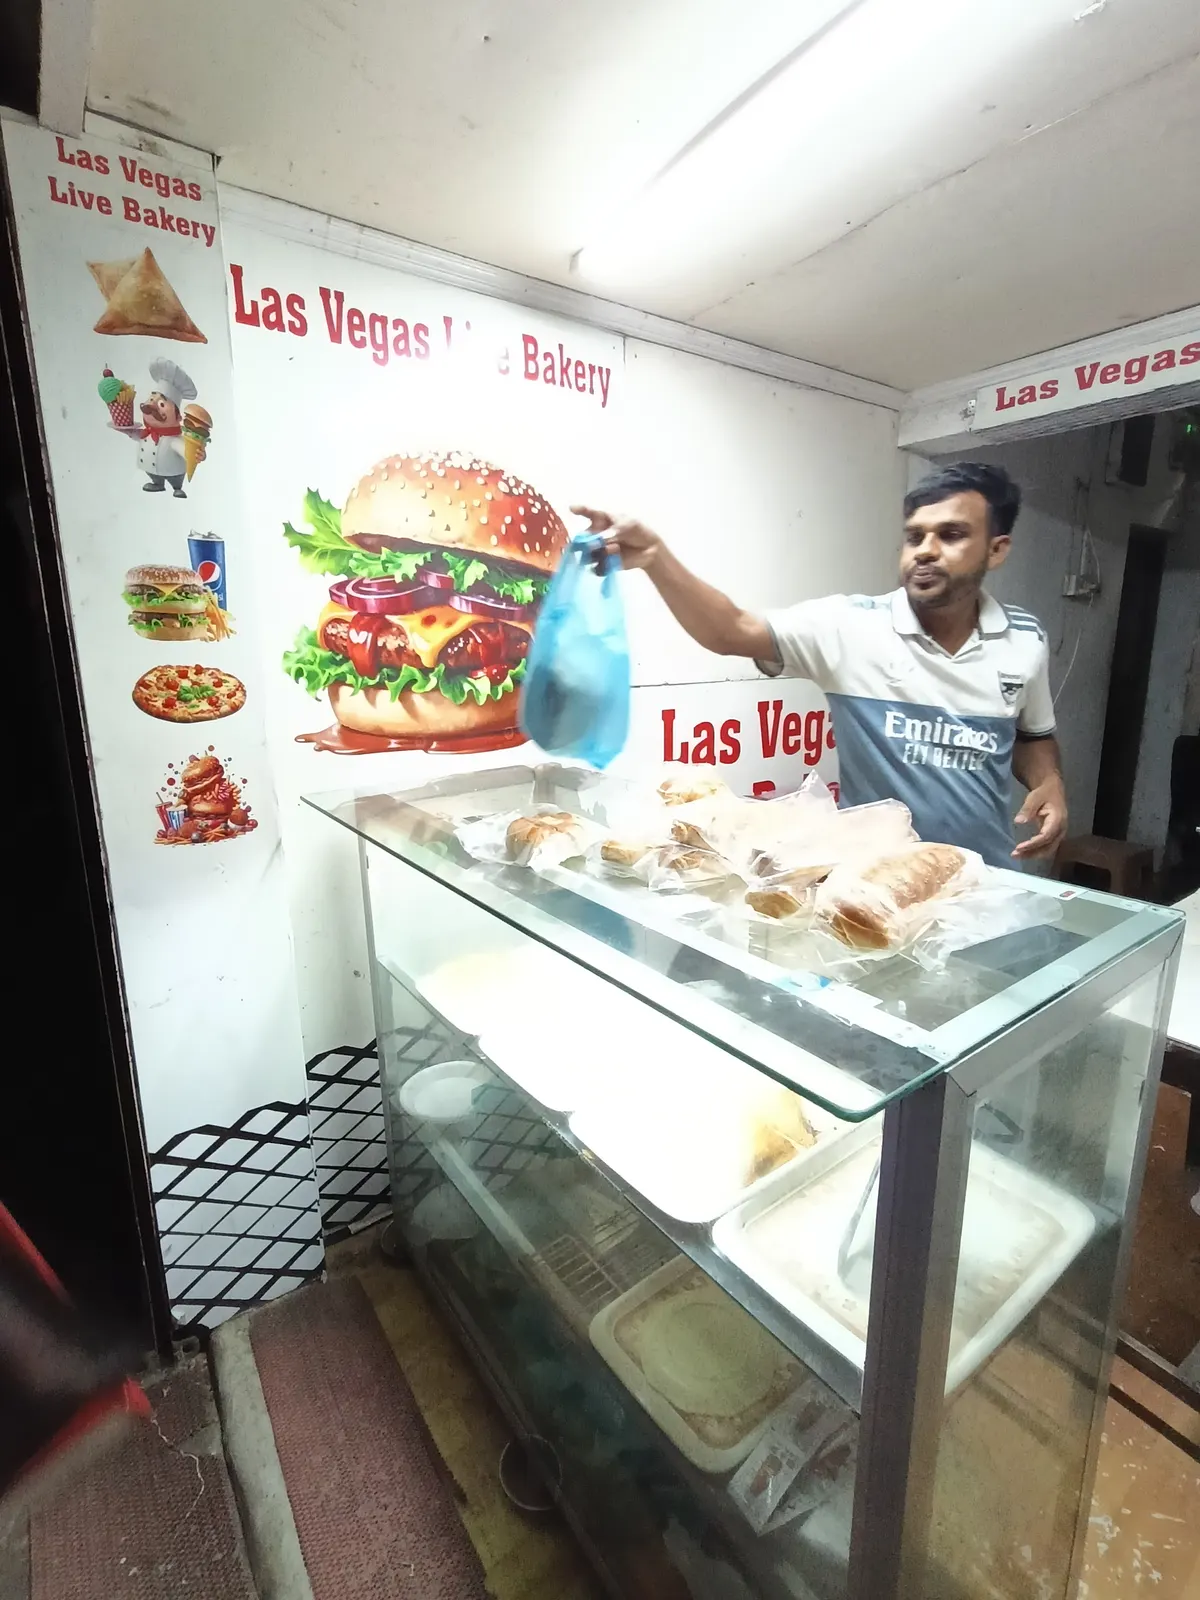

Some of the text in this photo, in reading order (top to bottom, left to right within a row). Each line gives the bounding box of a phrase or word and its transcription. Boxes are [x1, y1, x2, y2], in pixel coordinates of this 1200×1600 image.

[55, 136, 202, 201] Las Vegas
[48, 175, 216, 247] Live Bakery
[230, 263, 308, 337] Las
[319, 286, 430, 366] Vegas
[522, 333, 611, 408] Bakery
[995, 342, 1200, 411] Las Vegas
[661, 709, 741, 766] Las
[885, 711, 998, 753] Emirates
[902, 742, 990, 770] FLY BETTER
